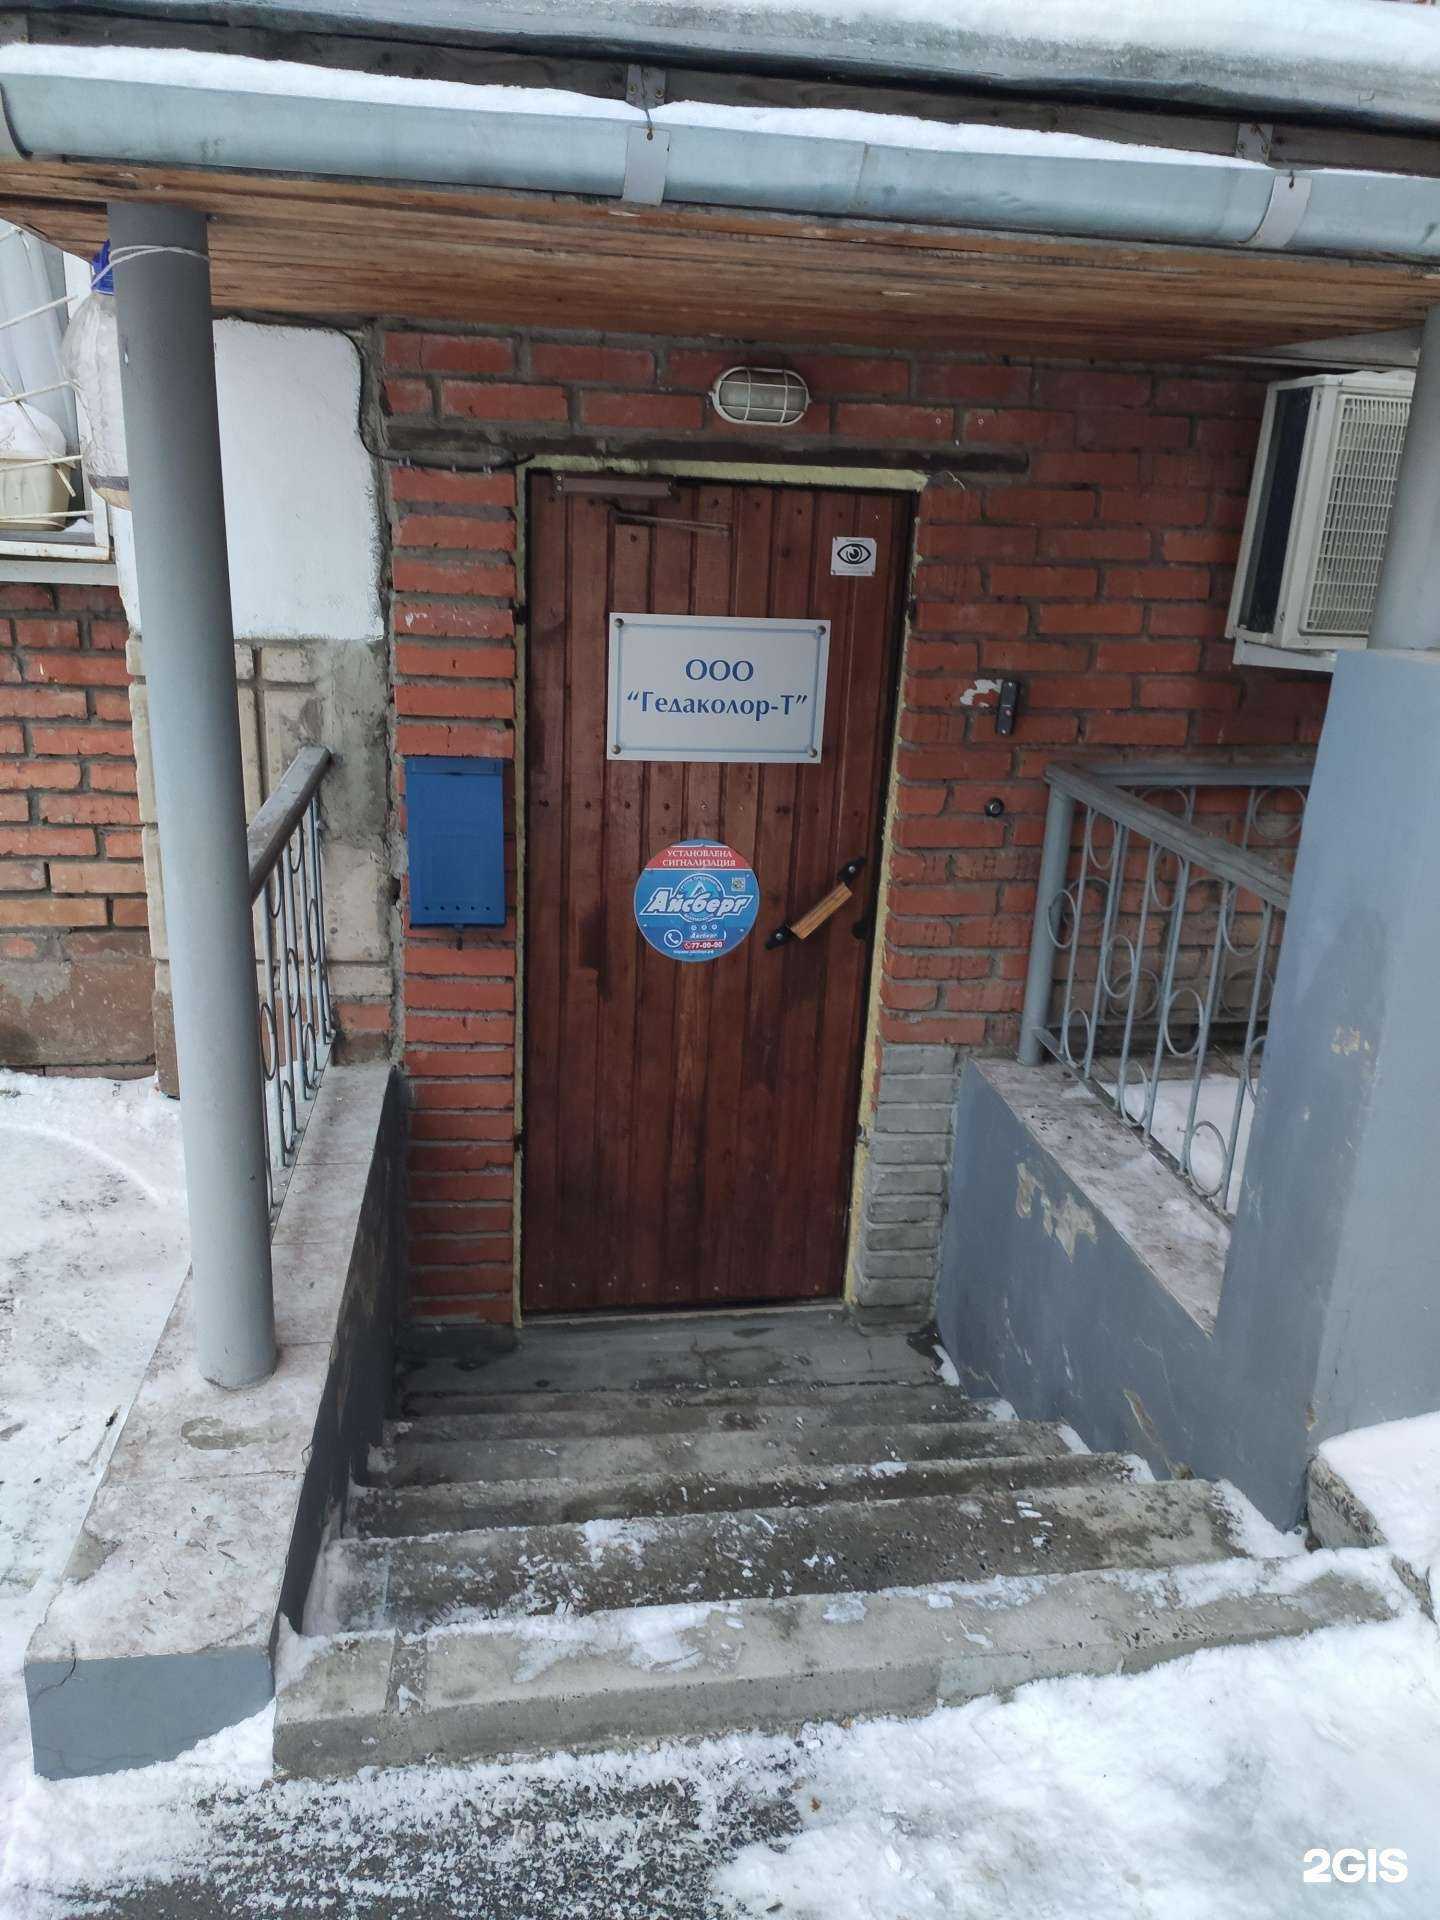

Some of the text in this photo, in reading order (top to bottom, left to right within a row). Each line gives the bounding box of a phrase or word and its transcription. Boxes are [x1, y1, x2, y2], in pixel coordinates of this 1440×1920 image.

[685, 658, 754, 682] ООО
[667, 849, 733, 858] УСТАНОВЛЕНА
[662, 859, 736, 867] СИГНАЛИЗАЦИЯ
[645, 889, 749, 917] Айсберг
